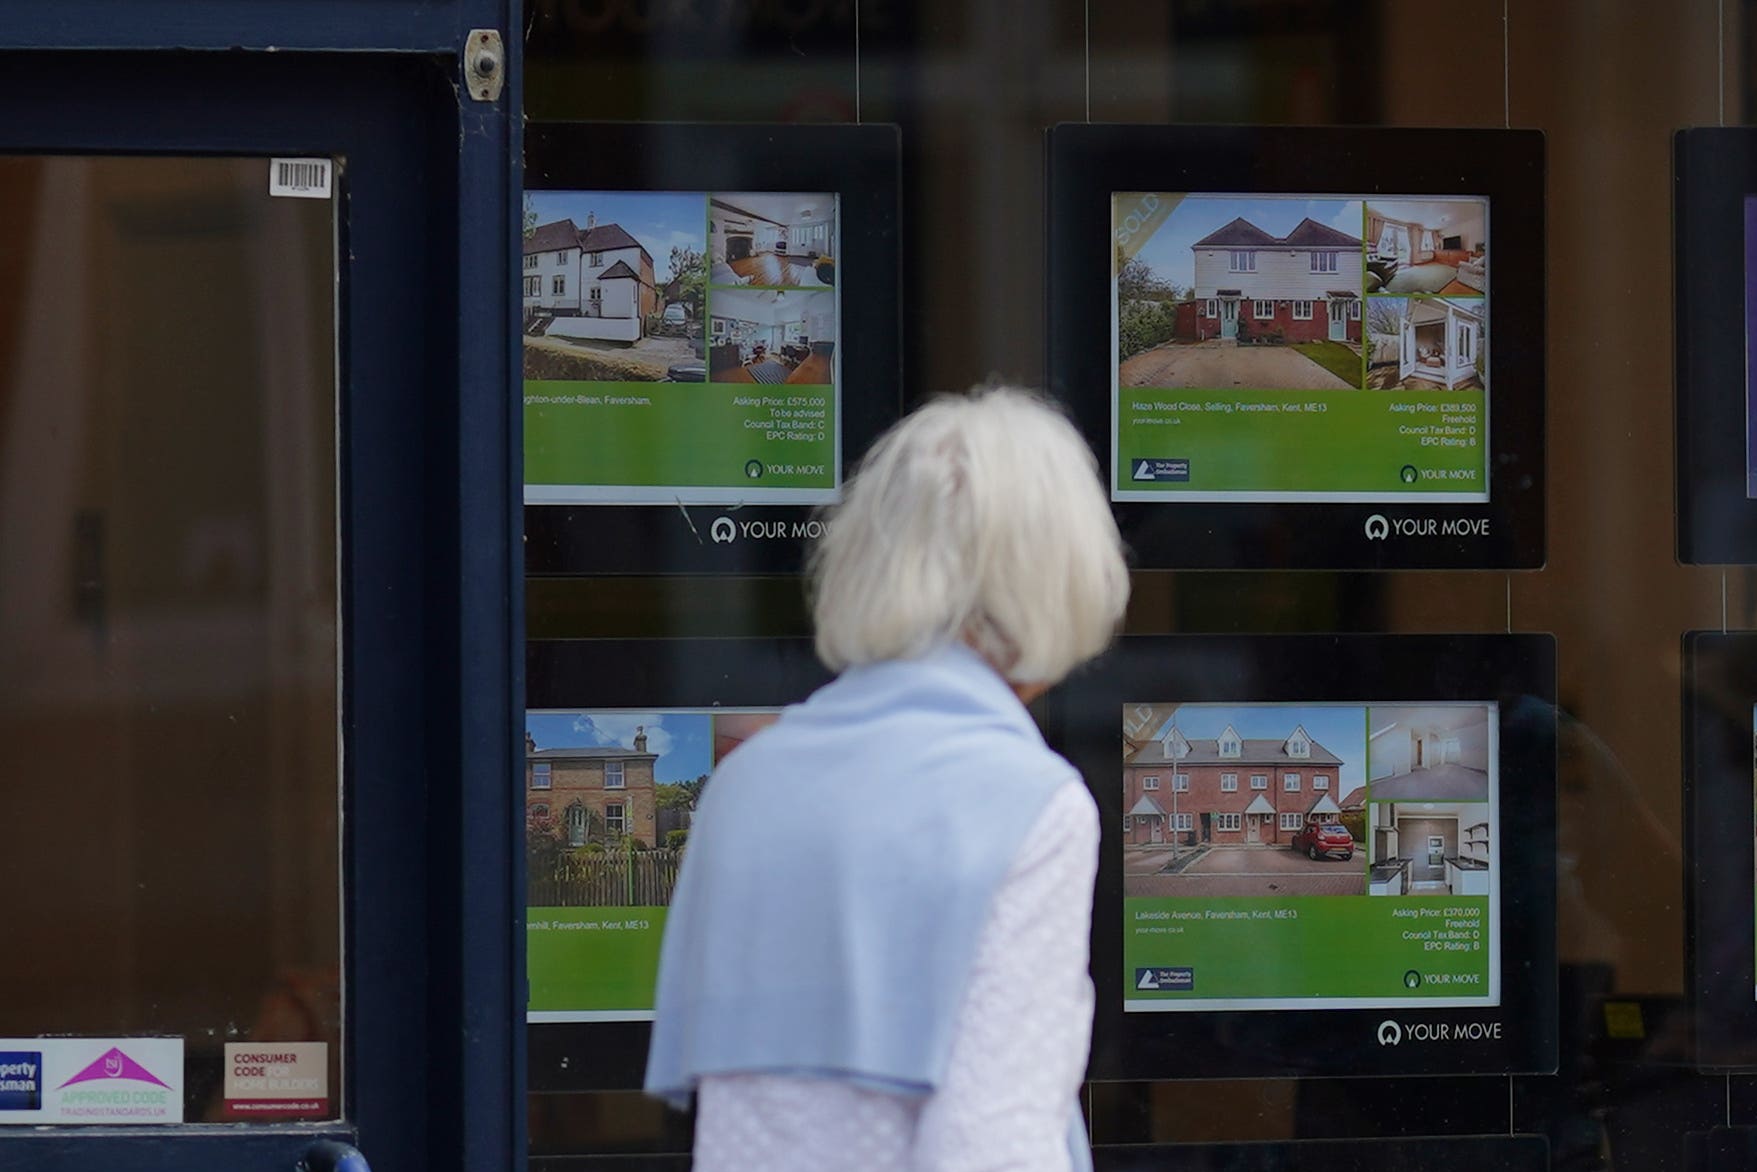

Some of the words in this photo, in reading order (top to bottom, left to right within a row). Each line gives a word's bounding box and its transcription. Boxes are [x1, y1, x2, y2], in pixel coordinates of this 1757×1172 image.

[1115, 193, 1159, 245] SOLD
[732, 397, 760, 408] Asking
[762, 397, 784, 406] Price:
[1304, 403, 1327, 412] ME13
[770, 409, 780, 418] To
[781, 410, 792, 418] be
[793, 410, 825, 418] advised
[1390, 404, 1415, 414] Asking
[1442, 414, 1476, 424] Freehold
[744, 420, 774, 428] Council
[776, 420, 790, 428] Tax
[792, 420, 816, 428] Band:
[818, 421, 825, 429] C
[1399, 426, 1428, 434] Council
[1430, 426, 1444, 434] Tax
[766, 431, 786, 440] EPC
[786, 432, 816, 442] Rating:
[818, 432, 825, 440] D
[1420, 437, 1439, 446] EPC
[767, 464, 794, 474] YOUR
[796, 465, 824, 474] MOVE
[1420, 470, 1448, 480] YOUR
[1449, 470, 1476, 480] MOVE
[740, 521, 786, 538] YOUR
[791, 521, 836, 538] MOV
[1392, 518, 1437, 536] YOUR
[1442, 518, 1490, 536] MOVE
[1274, 910, 1297, 919] ME13
[1392, 908, 1418, 918] Asking
[602, 920, 624, 930] Kent,
[624, 920, 649, 930] ME13
[1446, 918, 1480, 928] Freehold
[1402, 930, 1431, 939] Council
[1433, 930, 1447, 939] Tax
[1424, 942, 1442, 950] EPC
[1424, 974, 1450, 984] YOUR
[1452, 974, 1480, 984] MOVE
[1404, 1024, 1449, 1040] YOUR
[1454, 1023, 1502, 1040] MOVE
[234, 1054, 297, 1064] CONSUMER
[234, 1066, 265, 1076] CODE
[266, 1066, 290, 1076] FOR
[61, 1091, 131, 1104] APPROVED
[132, 1091, 167, 1104] CODE
